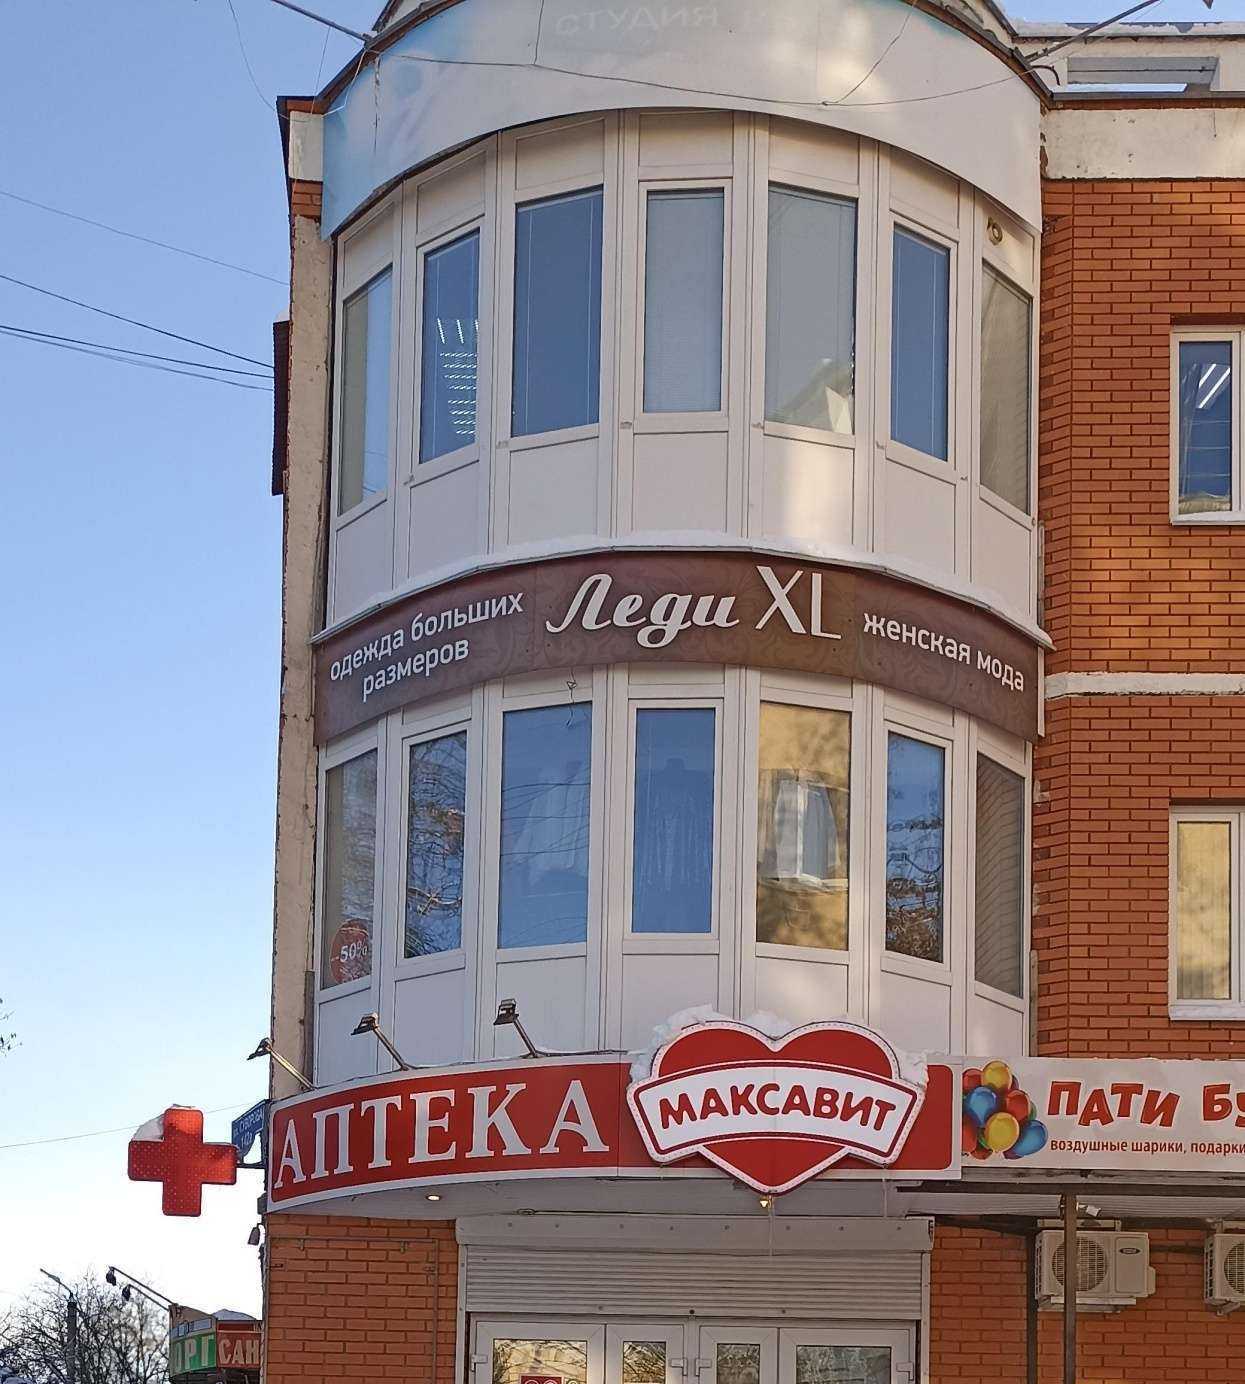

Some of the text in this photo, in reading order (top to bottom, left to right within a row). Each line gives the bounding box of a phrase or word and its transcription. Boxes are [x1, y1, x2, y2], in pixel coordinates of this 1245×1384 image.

[330, 592, 524, 681] одежда больших
[546, 565, 842, 649] Леди XL
[363, 639, 470, 702] размеров
[863, 613, 1024, 692] женская мода
[274, 1079, 610, 1189] АПТЕКА
[658, 1083, 897, 1131] МАКСАВИТ
[1047, 1081, 1180, 1127] ПАТИ
[1050, 1139, 1128, 1155] воздушные
[1131, 1140, 1187, 1155] шарики,
[219, 1339, 260, 1365] САН
